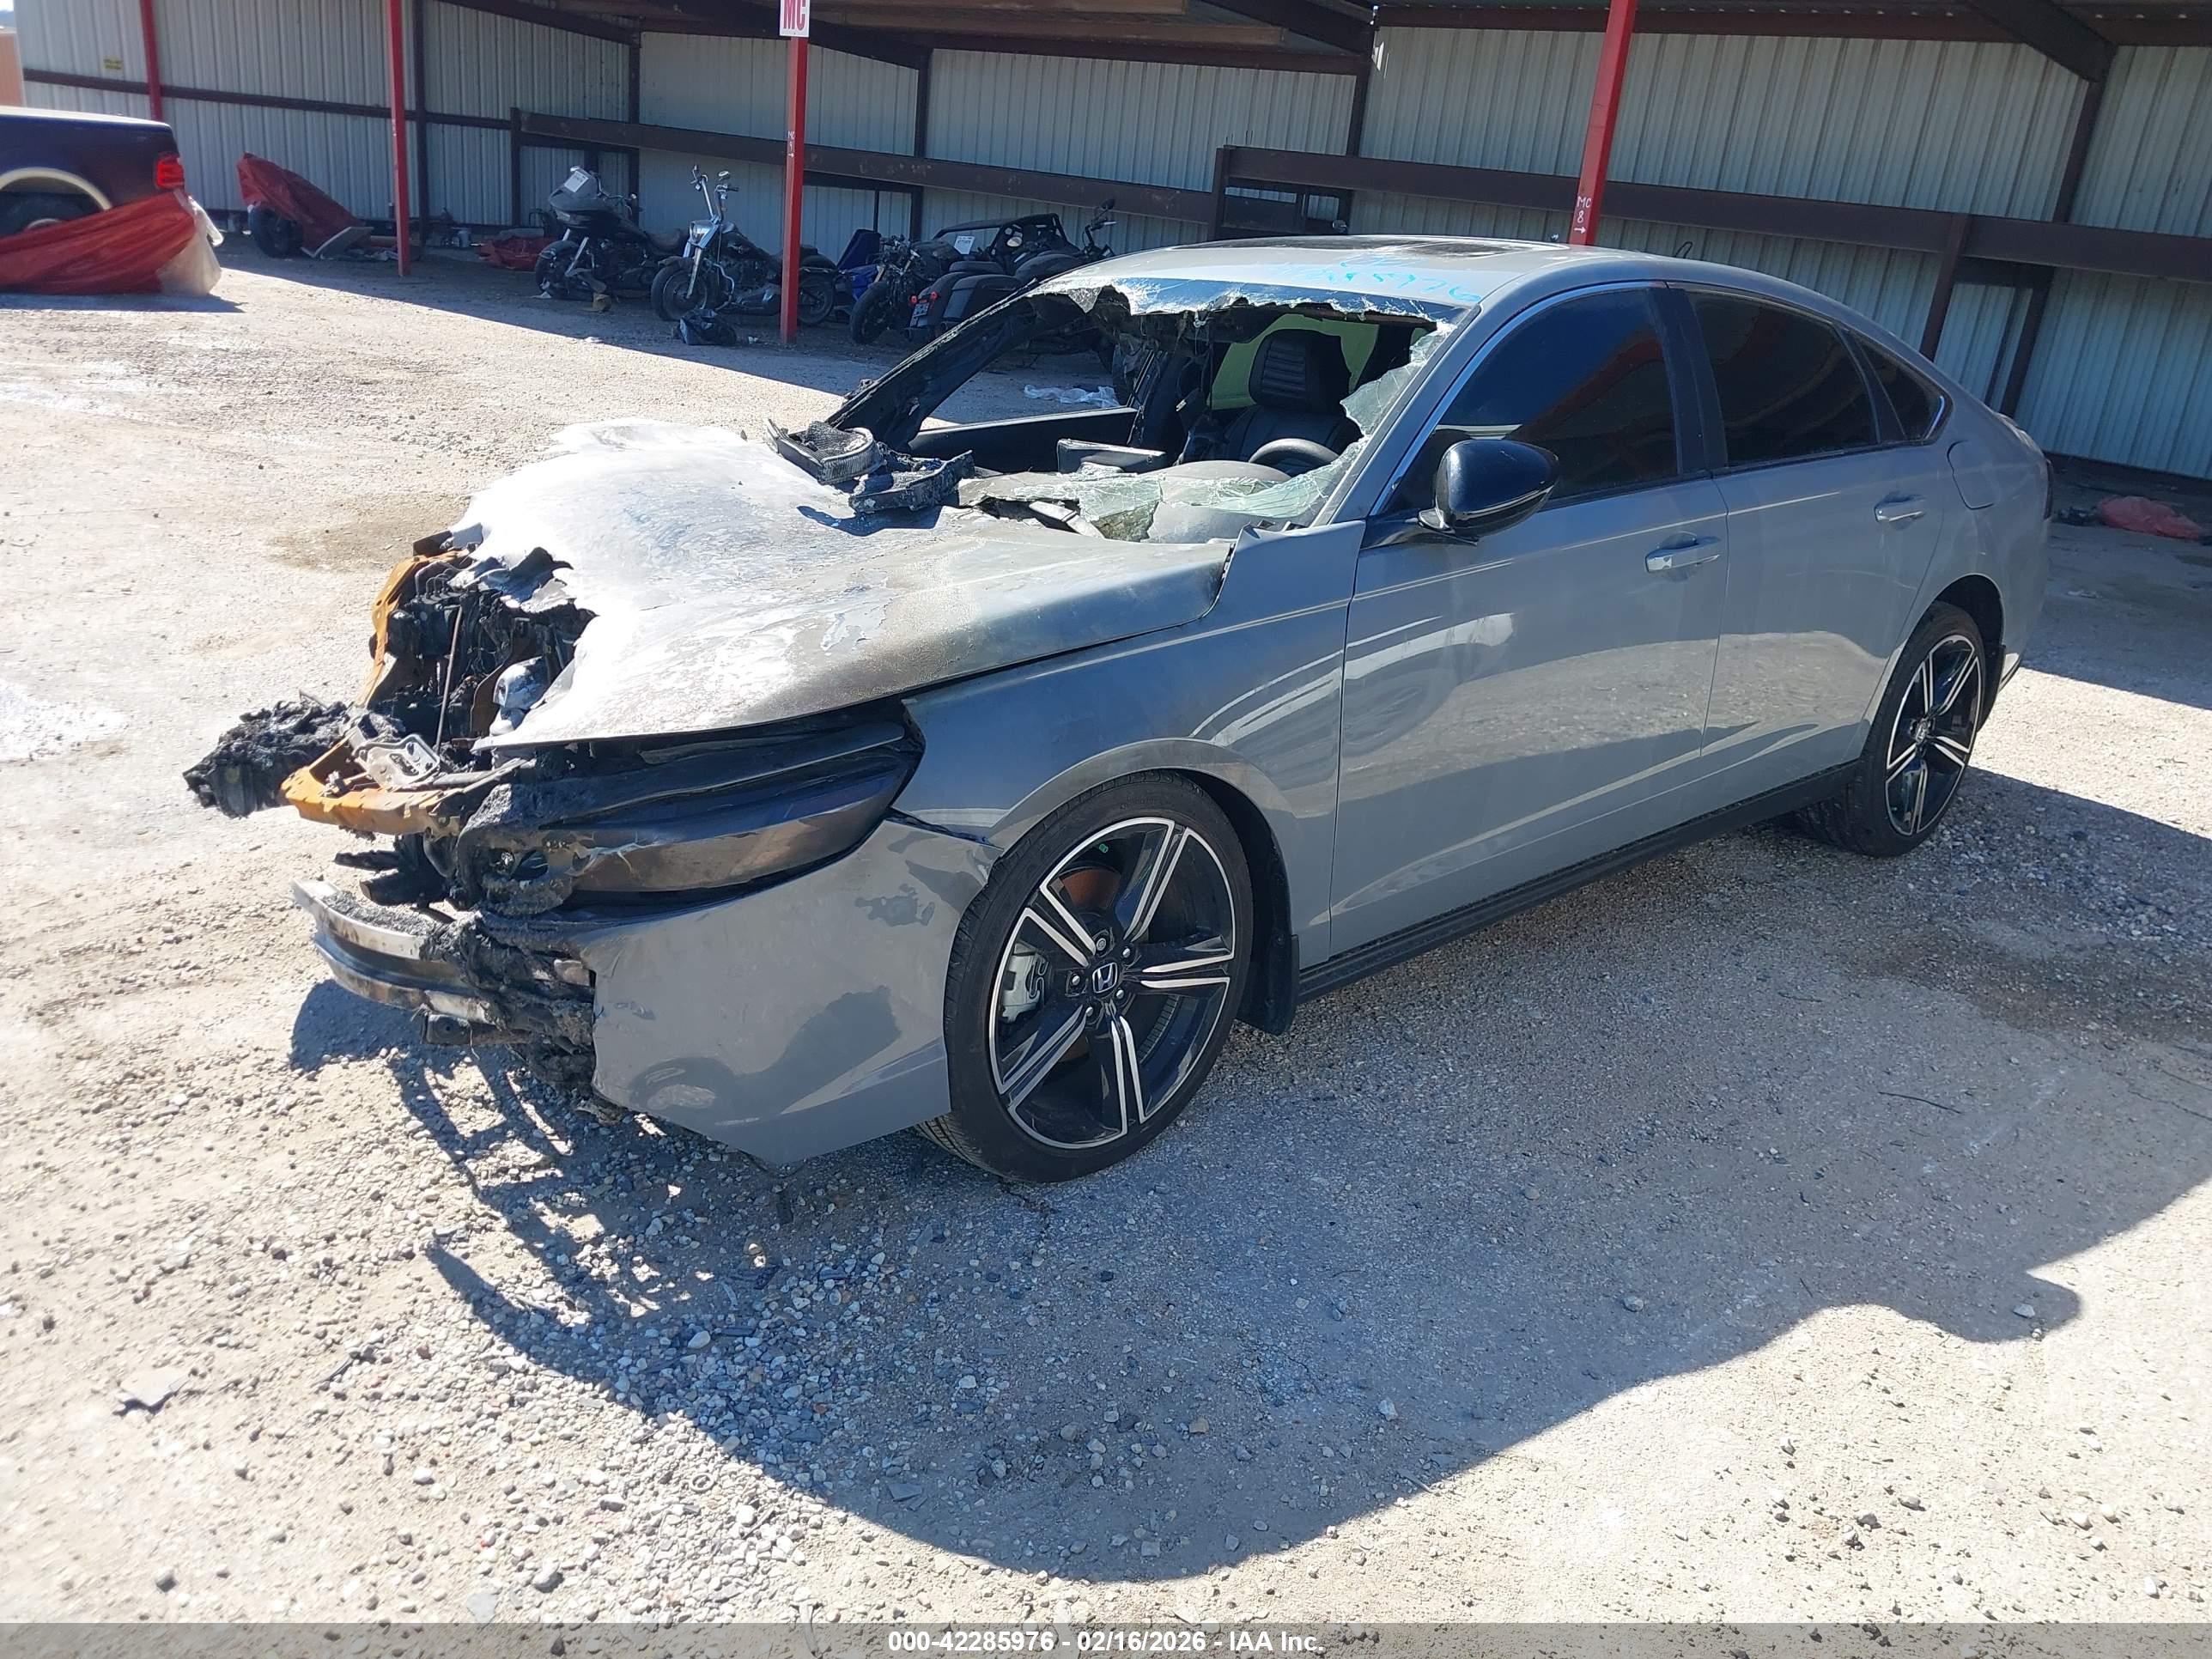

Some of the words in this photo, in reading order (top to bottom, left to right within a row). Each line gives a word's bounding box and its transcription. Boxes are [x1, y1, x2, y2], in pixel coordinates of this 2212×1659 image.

[783, 0, 805, 31] MC
[1577, 196, 1592, 208] MC
[1577, 210, 1584, 223] 8
